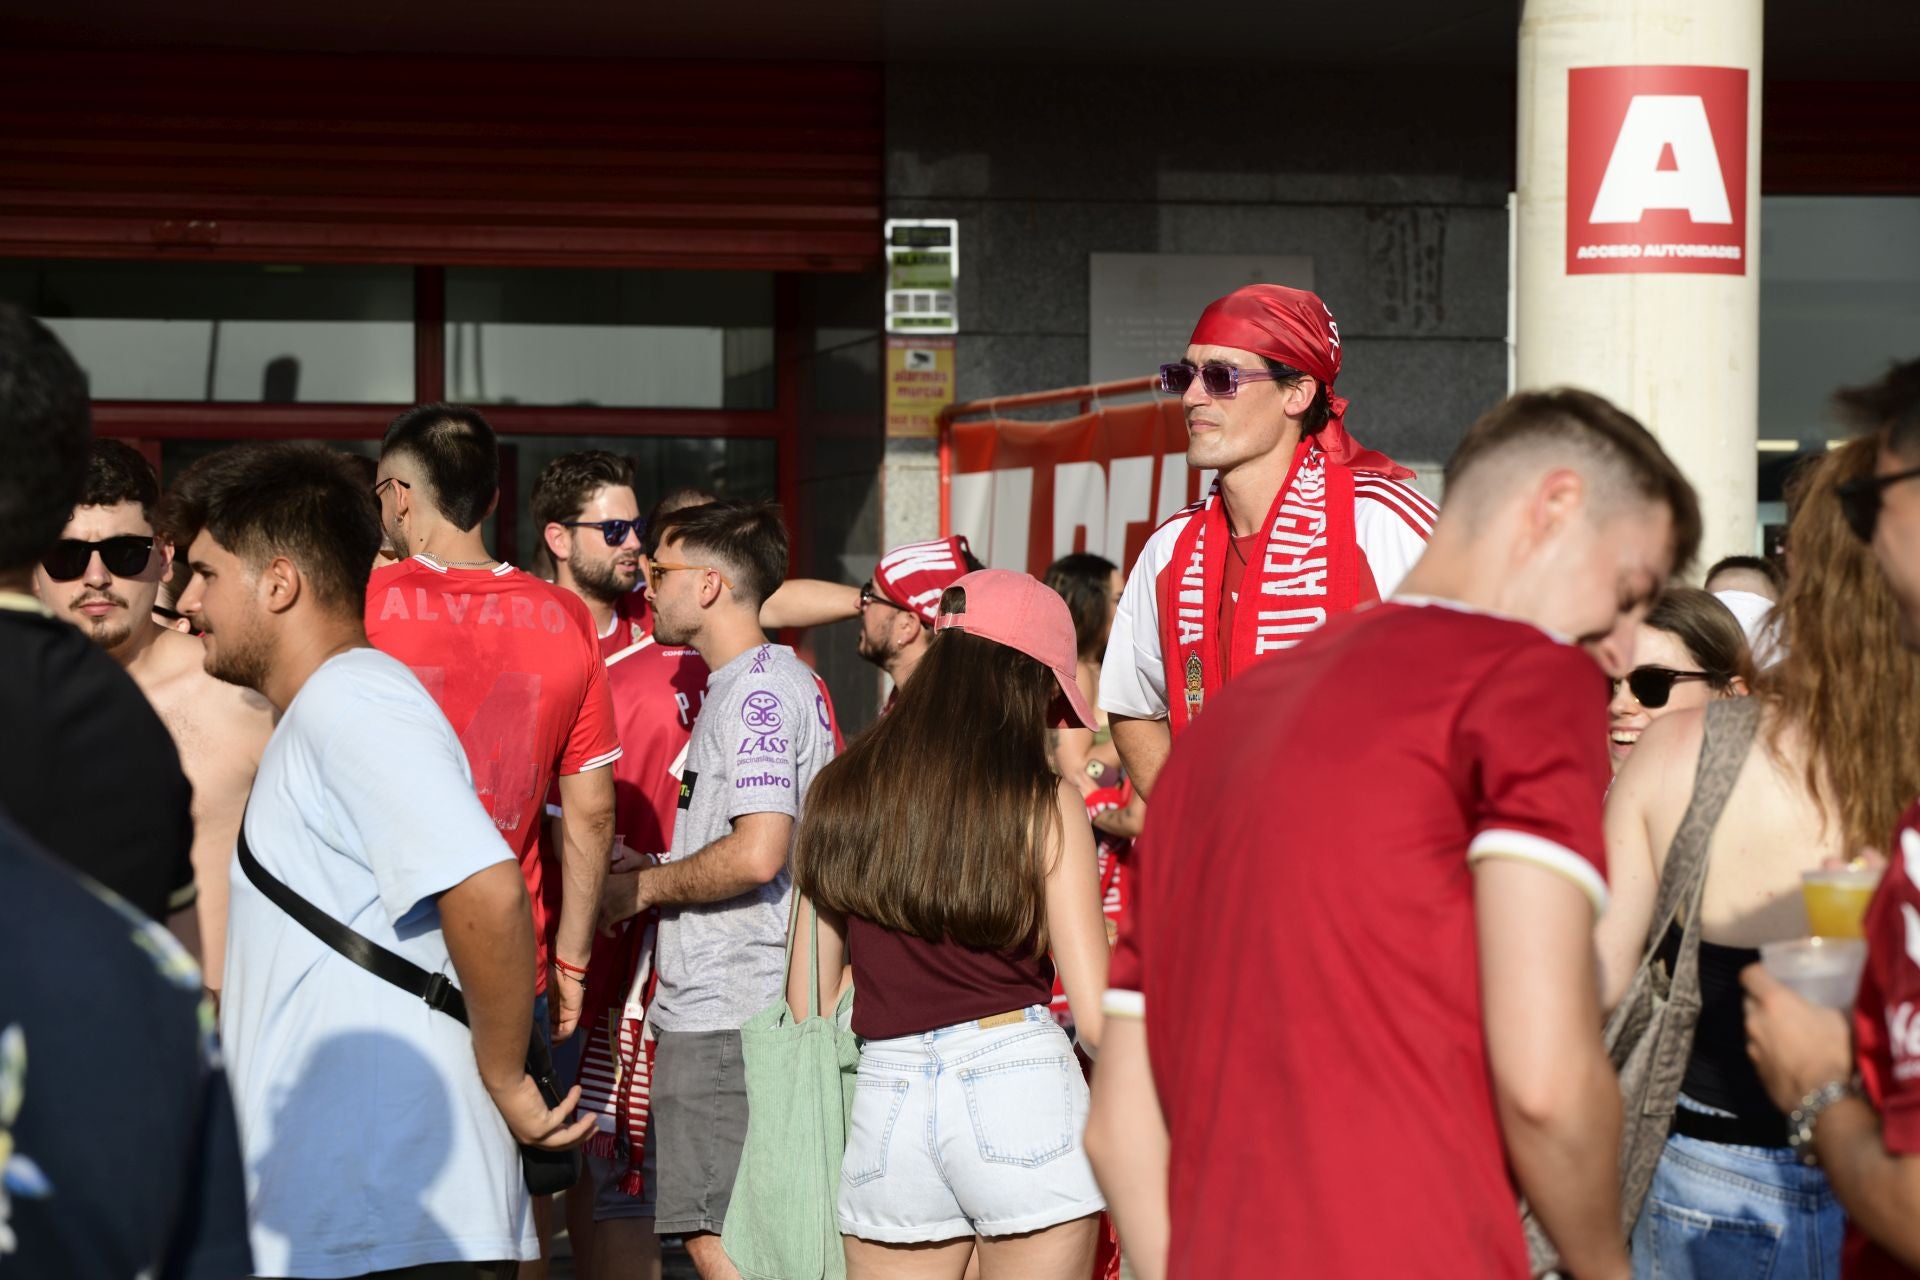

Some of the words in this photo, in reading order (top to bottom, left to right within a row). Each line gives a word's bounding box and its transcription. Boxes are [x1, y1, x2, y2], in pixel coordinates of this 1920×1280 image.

[1589, 95, 1733, 224] A
[1576, 245, 1641, 259] ACCESO
[380, 587, 566, 634] ALVARO
[737, 736, 789, 755] LASS
[735, 771, 791, 789] umbro
